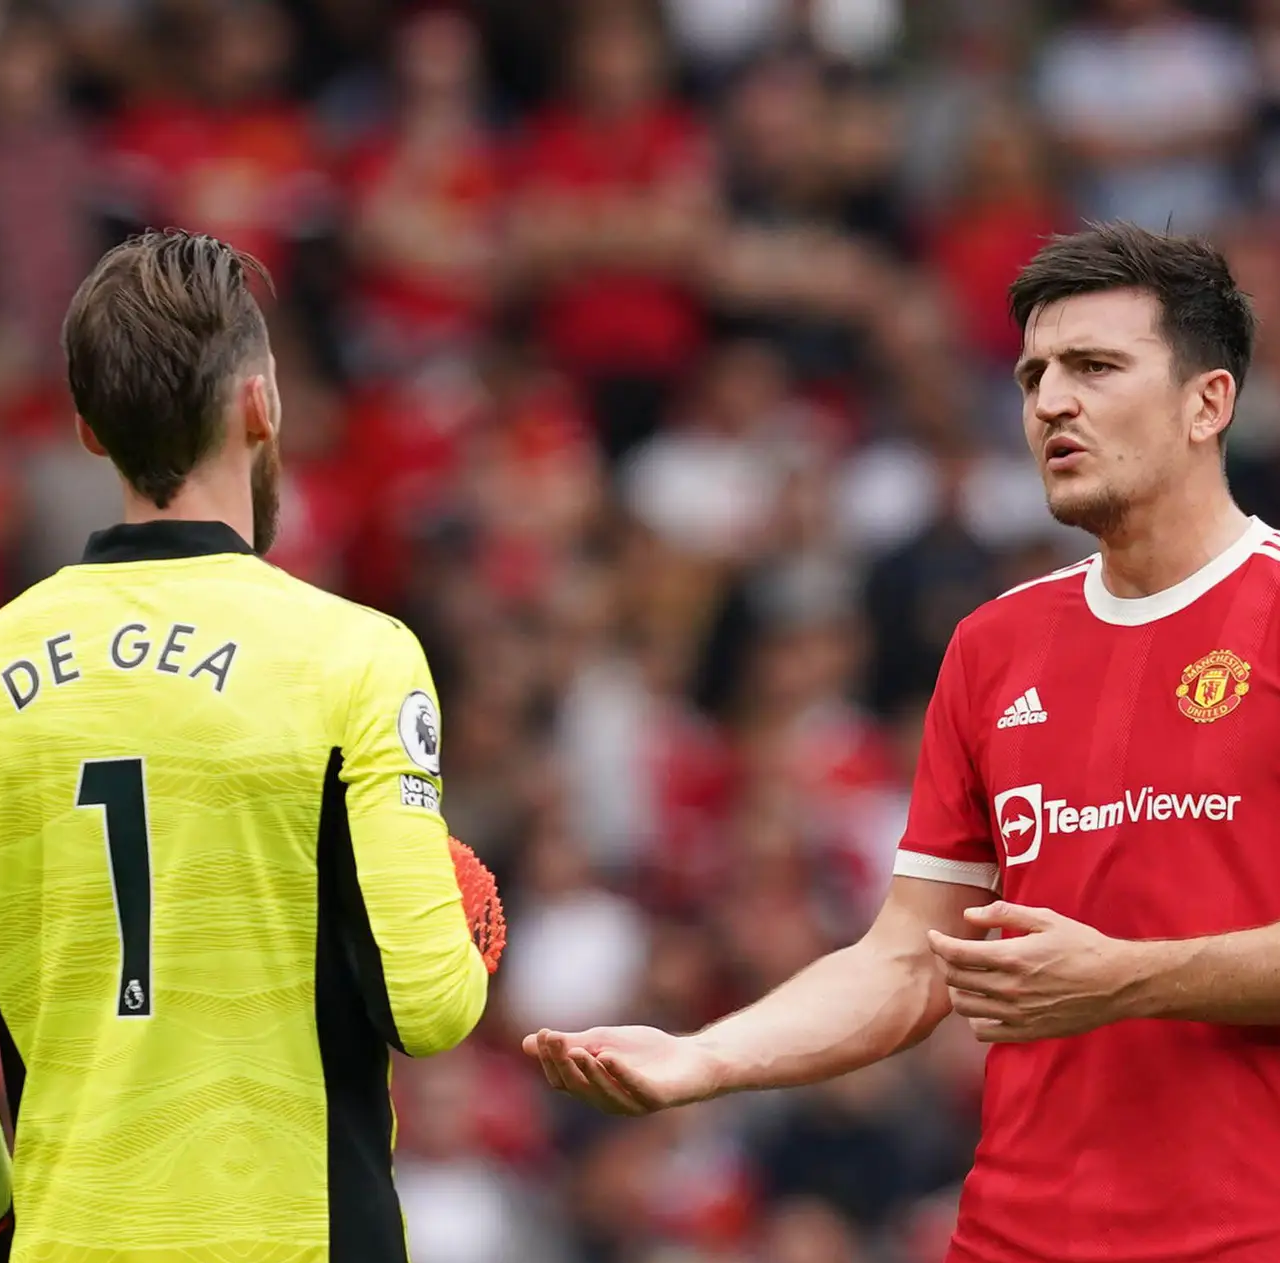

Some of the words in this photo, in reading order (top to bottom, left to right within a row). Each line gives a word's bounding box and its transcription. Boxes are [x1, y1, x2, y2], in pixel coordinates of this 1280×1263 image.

[2, 633, 80, 711] DE
[110, 624, 238, 692] GEA
[1187, 654, 1244, 679] MANCHESTER
[997, 709, 1048, 729] adidas
[1187, 704, 1229, 718] UNITED
[1043, 786, 1241, 834] TeamViewer
[75, 756, 153, 1019] 1
